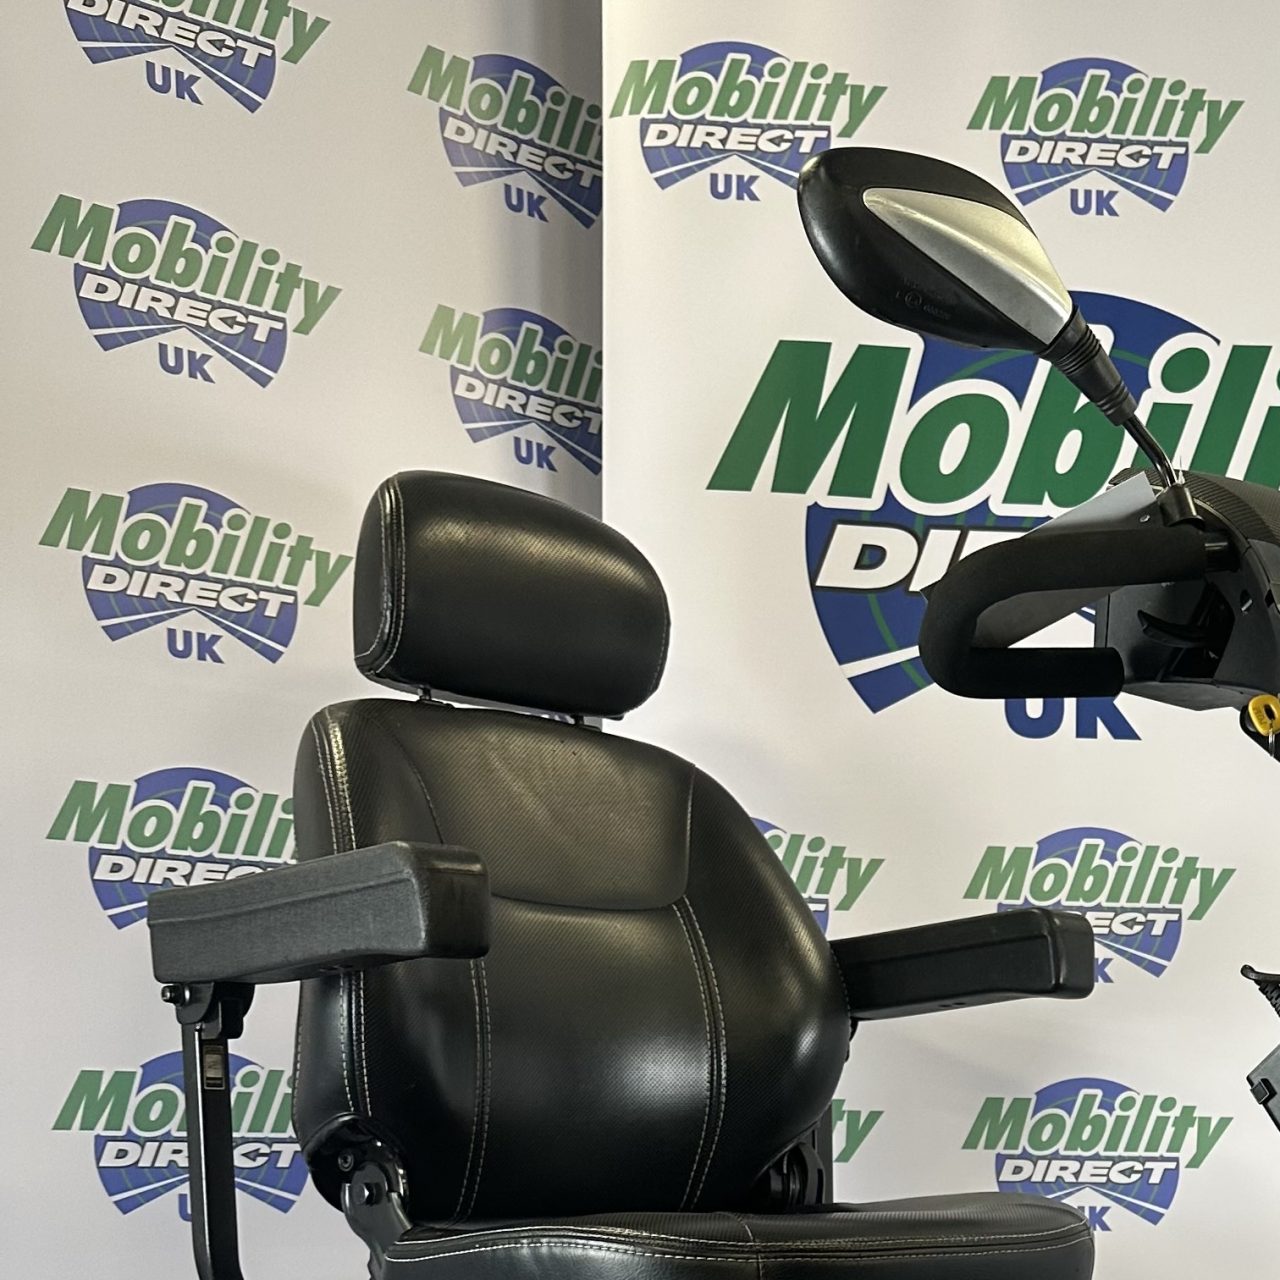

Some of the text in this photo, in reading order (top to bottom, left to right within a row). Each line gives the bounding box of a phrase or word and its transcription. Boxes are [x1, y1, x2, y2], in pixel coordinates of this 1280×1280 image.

[146, 60, 203, 105] UK
[407, 45, 603, 160] Mobili
[609, 58, 888, 138] Mobility
[642, 124, 828, 153] DIRECT
[967, 74, 1245, 154] Mobility
[443, 117, 602, 188] DIRECT
[1004, 142, 1186, 170] DIRECT
[504, 184, 549, 222] UK
[710, 173, 760, 201] UK
[1069, 188, 1119, 217] UK
[31, 194, 343, 335] Mobility
[80, 274, 284, 343] DIRECT
[159, 343, 214, 383] UK
[418, 304, 602, 403] Mobili
[514, 436, 558, 472] UK
[39, 487, 353, 607] Mobility
[87, 566, 296, 618] DIRECT
[167, 628, 225, 664] UK
[46, 780, 295, 859] Mobili
[93, 854, 275, 887] DIRE
[963, 844, 1238, 921] Mobility
[52, 1070, 293, 1132] Moili
[99, 1141, 301, 1168] DIRCT
[961, 1095, 1234, 1169] Mobility
[999, 1160, 1177, 1185] DIRECT
